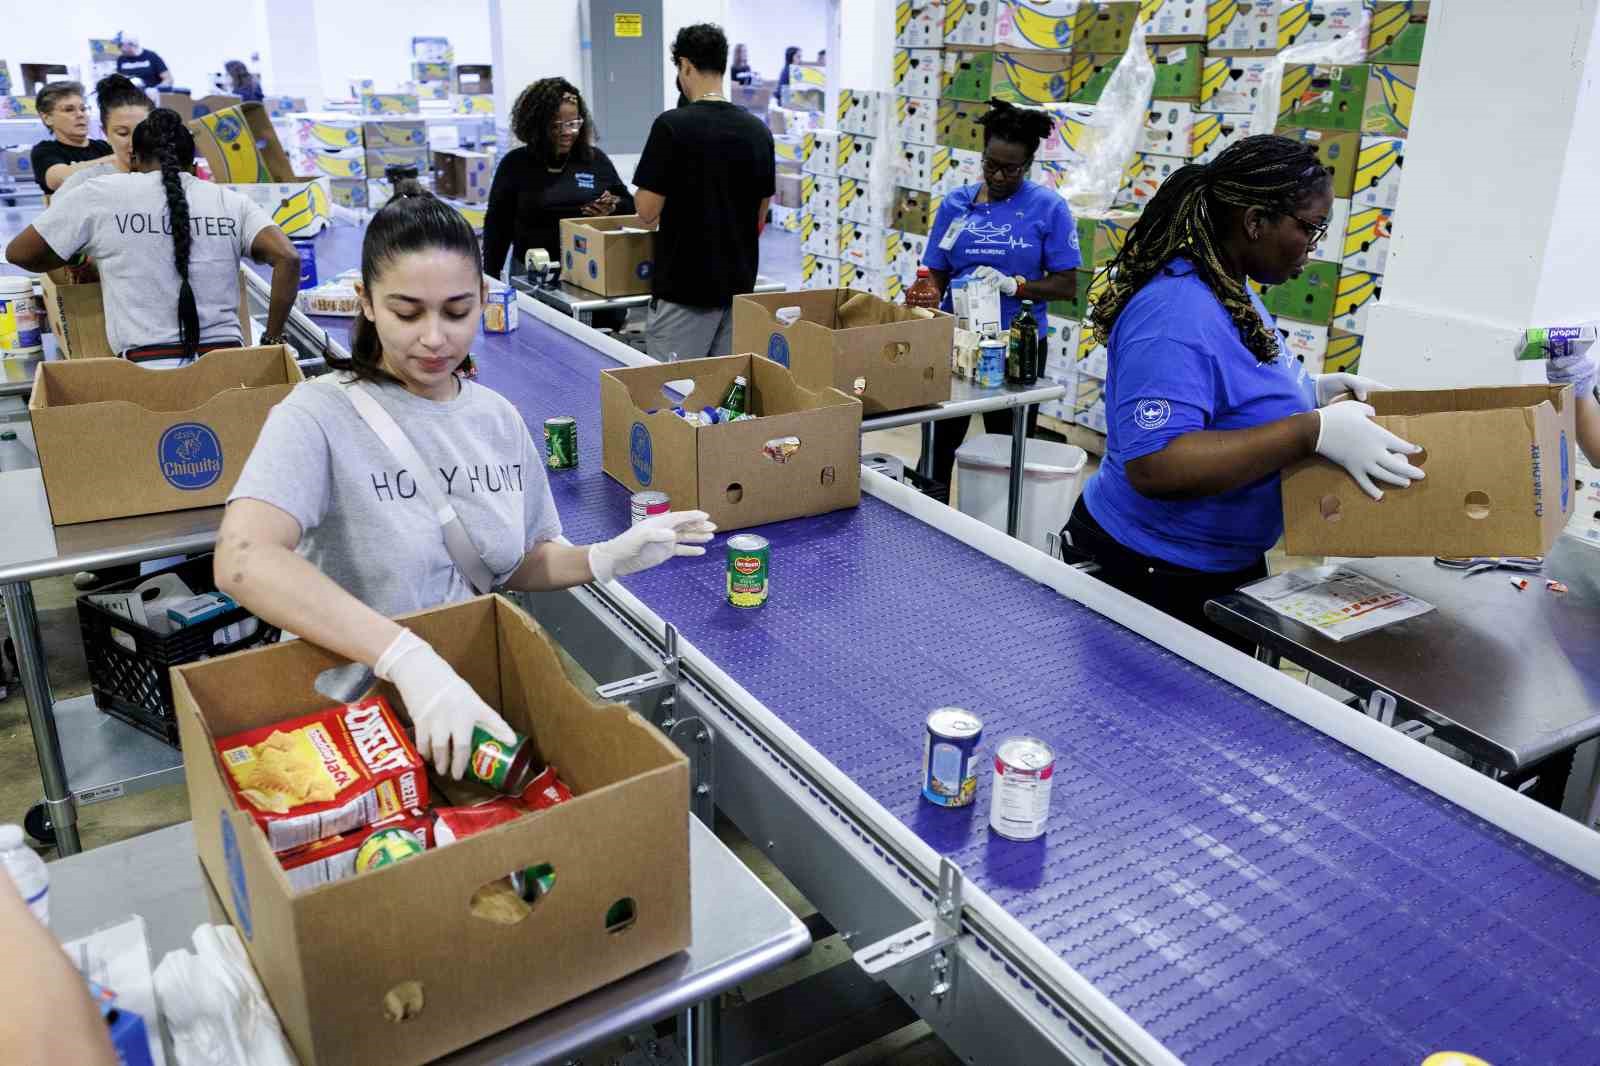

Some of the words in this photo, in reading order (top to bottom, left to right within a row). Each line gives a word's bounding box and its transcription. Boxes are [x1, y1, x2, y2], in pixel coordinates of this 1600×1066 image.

[115, 213, 237, 237] VOLUTEER
[163, 457, 220, 479] Chiquita
[371, 466, 458, 501] HOY
